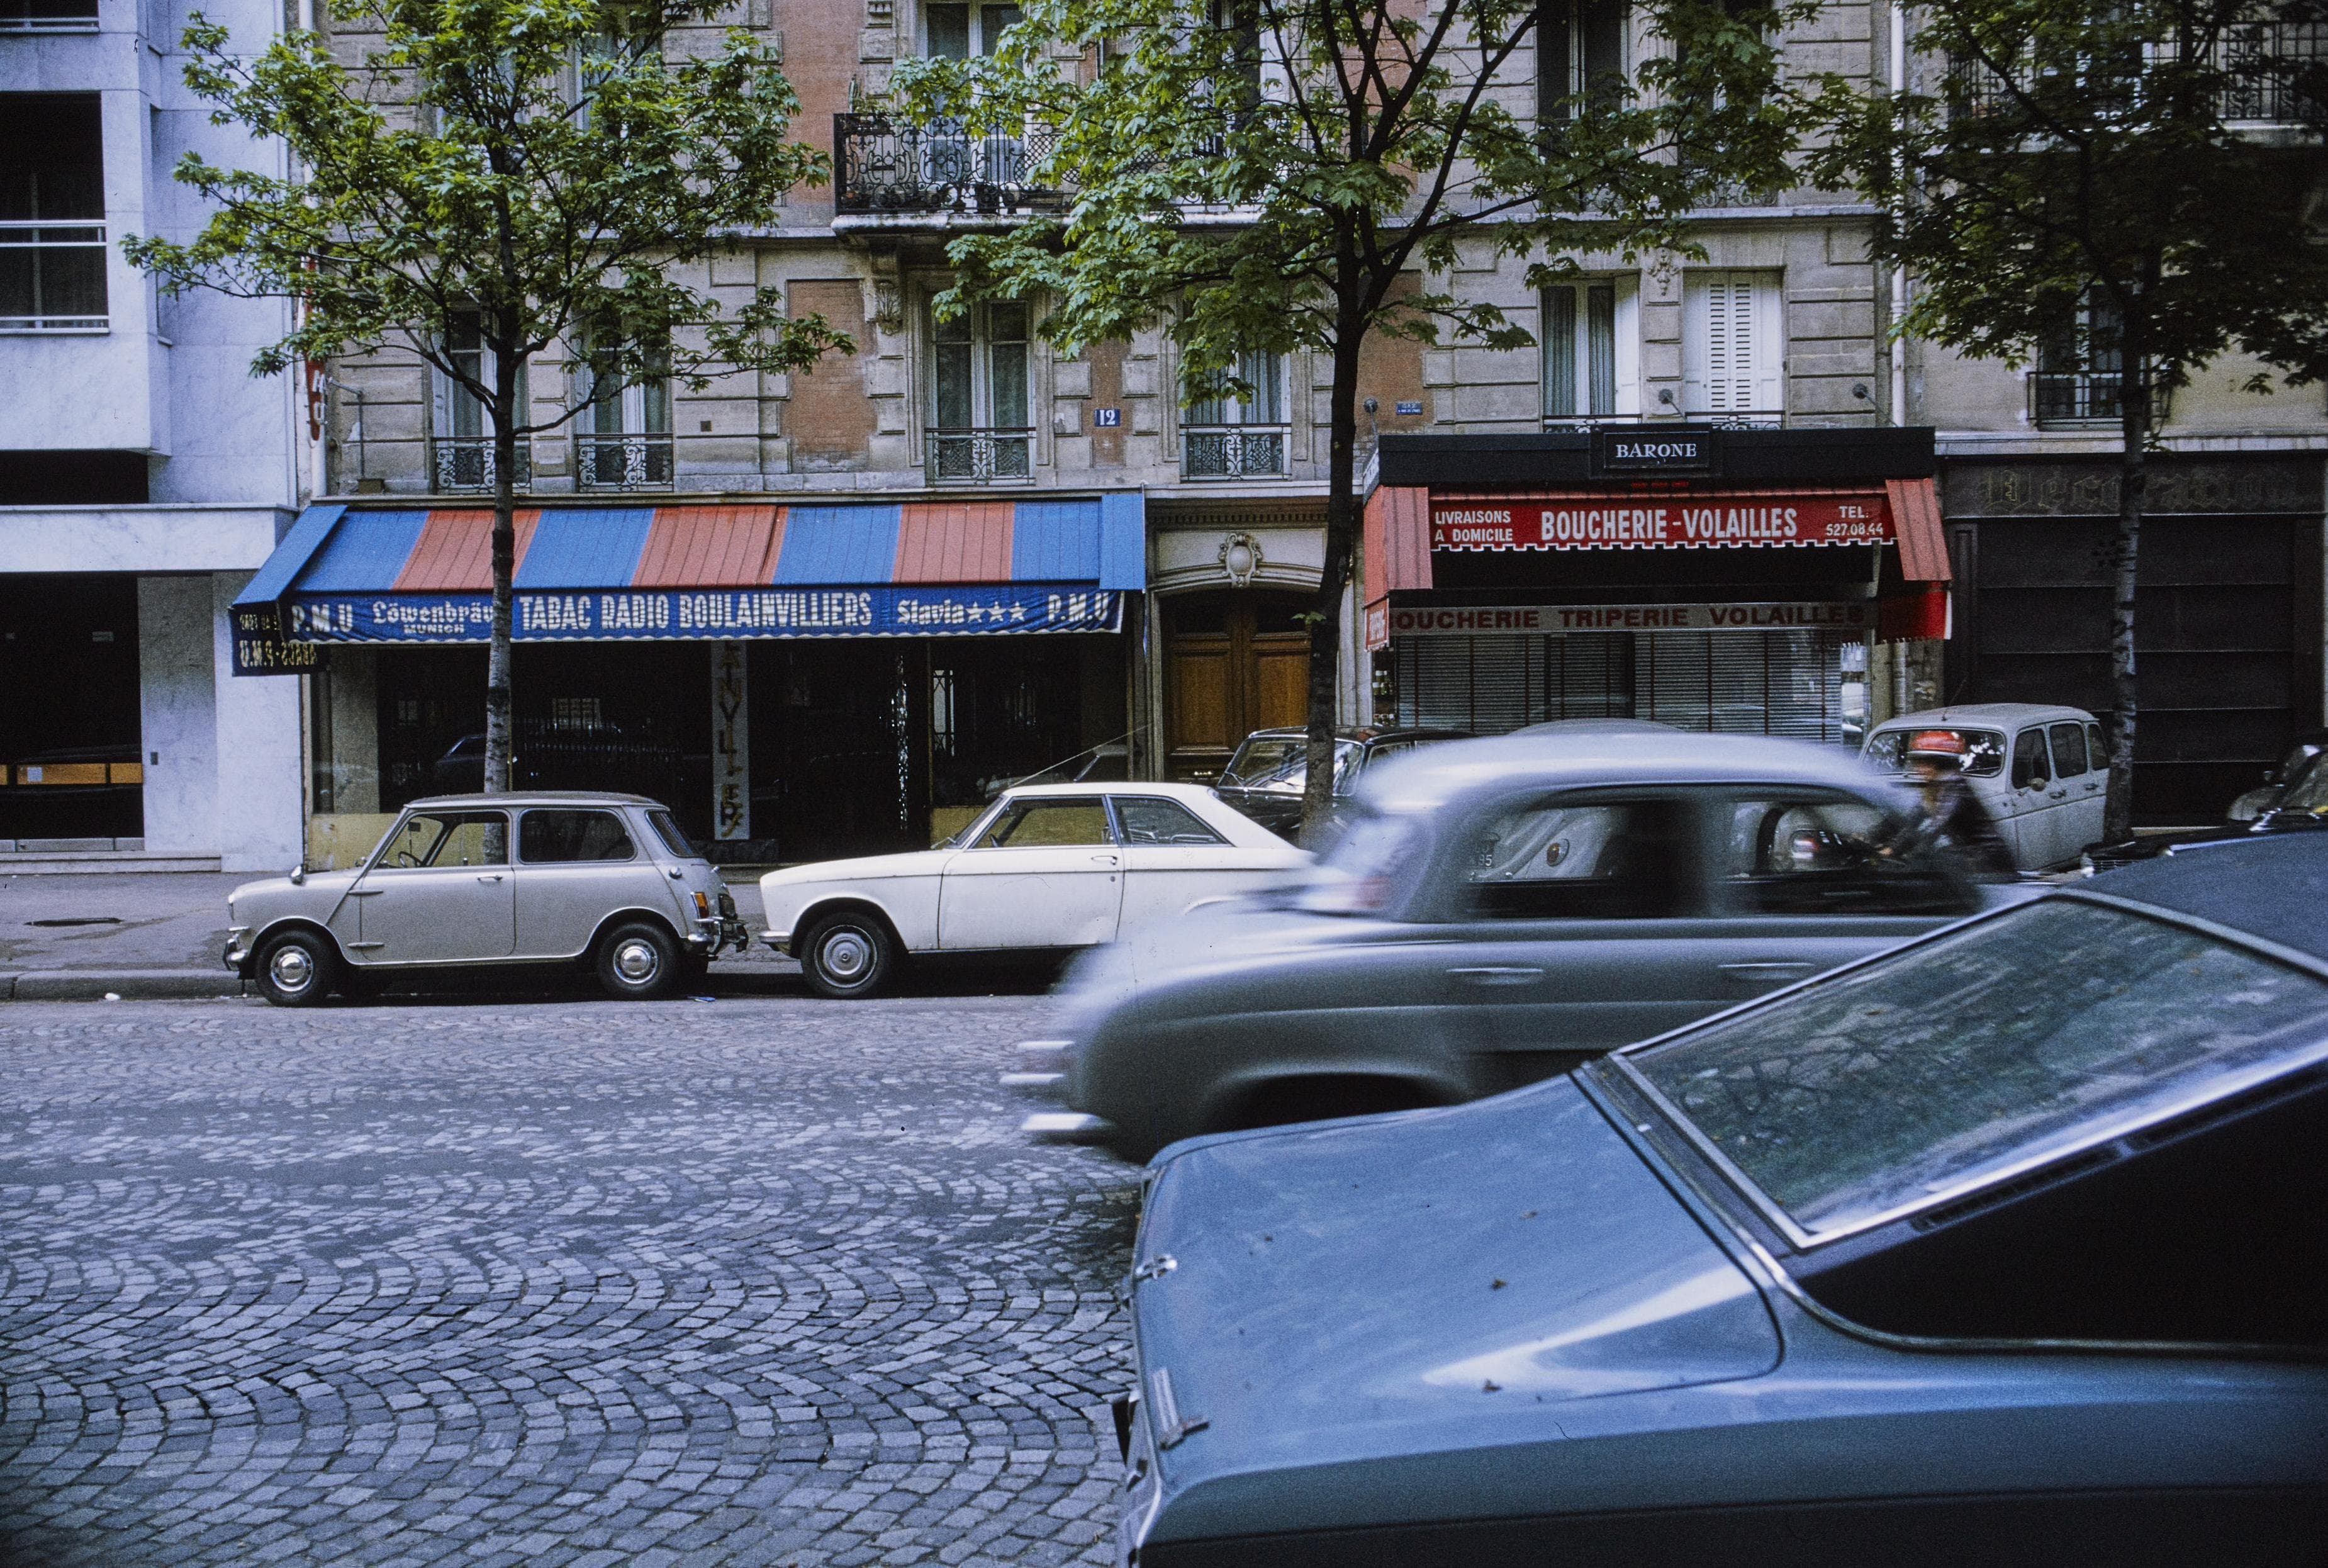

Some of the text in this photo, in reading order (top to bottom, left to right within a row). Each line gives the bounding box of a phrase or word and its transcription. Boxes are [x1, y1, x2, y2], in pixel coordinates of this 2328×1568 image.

[1100, 410, 1116, 425] 12
[1616, 443, 1697, 458] BARONE
[1435, 510, 1511, 525] LIVRAISONS
[1434, 529, 1513, 542] A DOMICILE
[1826, 523, 1883, 536] 527.08.44
[519, 592, 871, 629] TABAC RADIO BOULAINVILLIERS
[897, 599, 965, 624] Slavia
[1048, 592, 1109, 622] P.M.U
[292, 605, 354, 632] P.M.U
[1559, 608, 1689, 627] TRIPERIE
[1708, 605, 1864, 625] VOLAILLES
[403, 624, 464, 633] MUNICH
